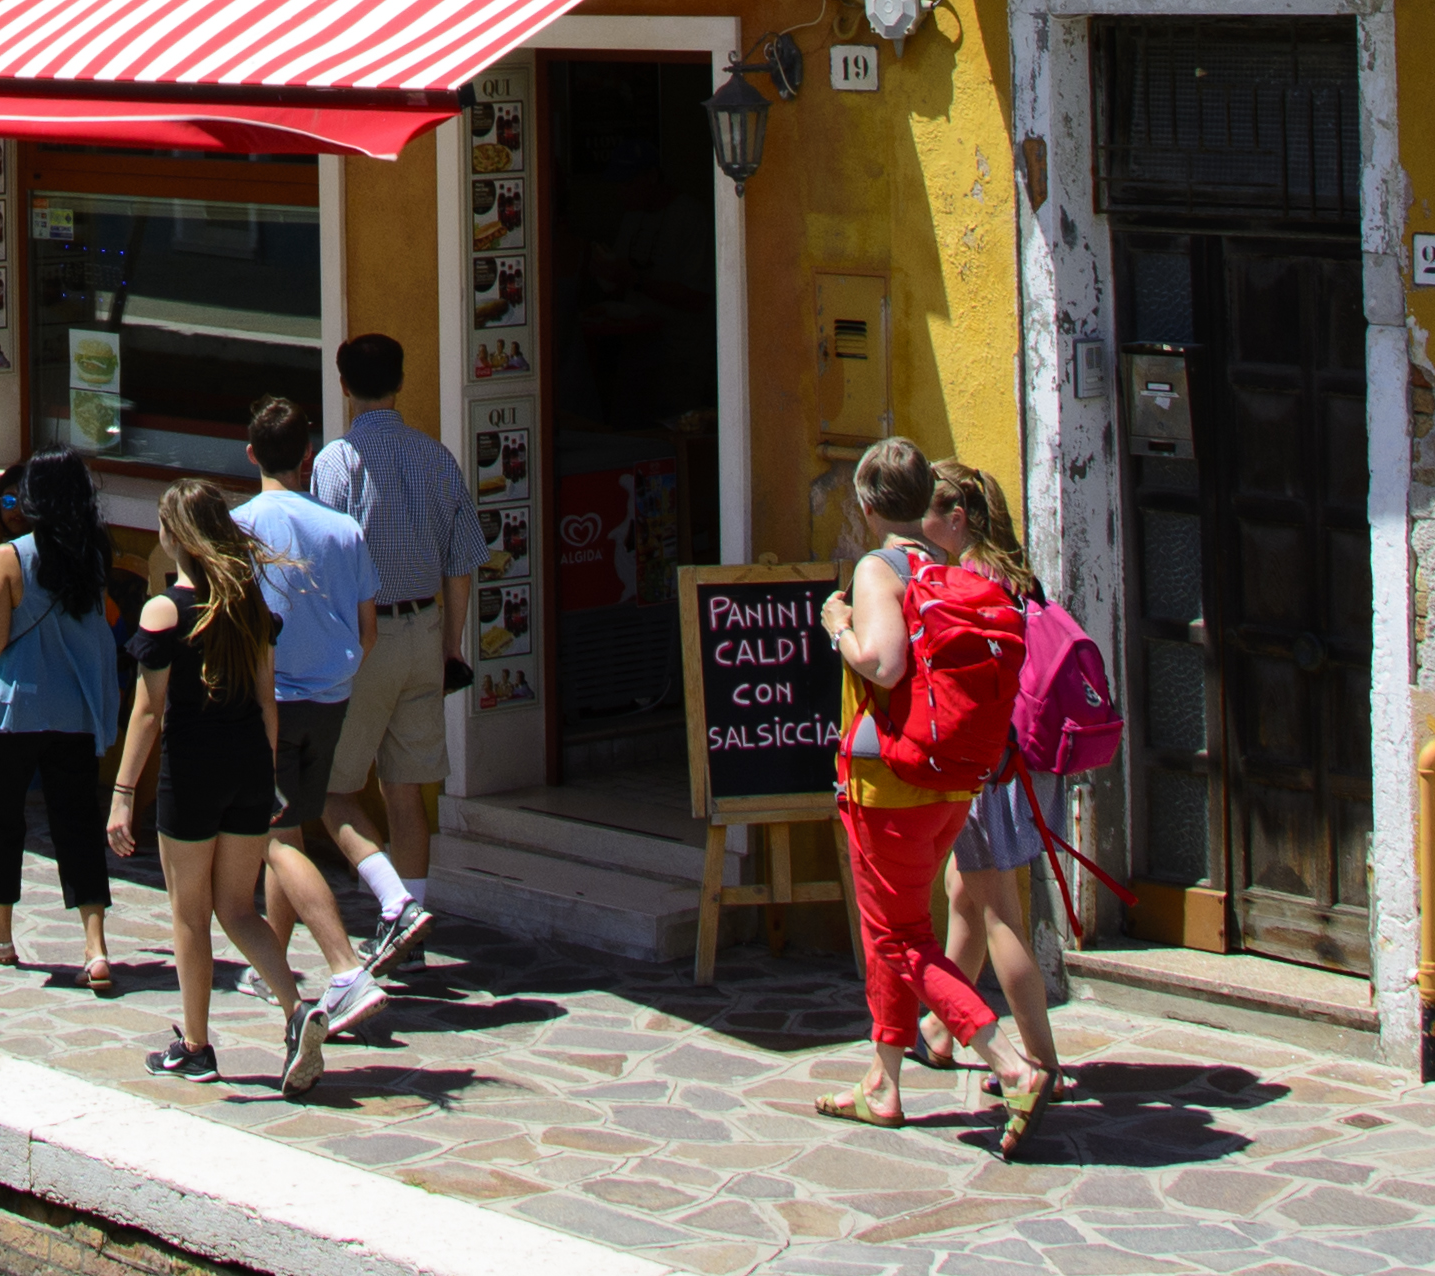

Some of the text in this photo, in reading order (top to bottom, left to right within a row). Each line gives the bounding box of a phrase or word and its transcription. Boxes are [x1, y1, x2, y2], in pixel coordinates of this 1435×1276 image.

[840, 54, 869, 81] 19
[482, 79, 511, 98] QUI
[488, 408, 516, 427] QUI
[560, 549, 603, 565] ALGIDA
[708, 591, 816, 631] PANINI
[714, 631, 811, 667] CALDI
[732, 681, 793, 706] CON
[709, 713, 841, 751] SALSICCIA
